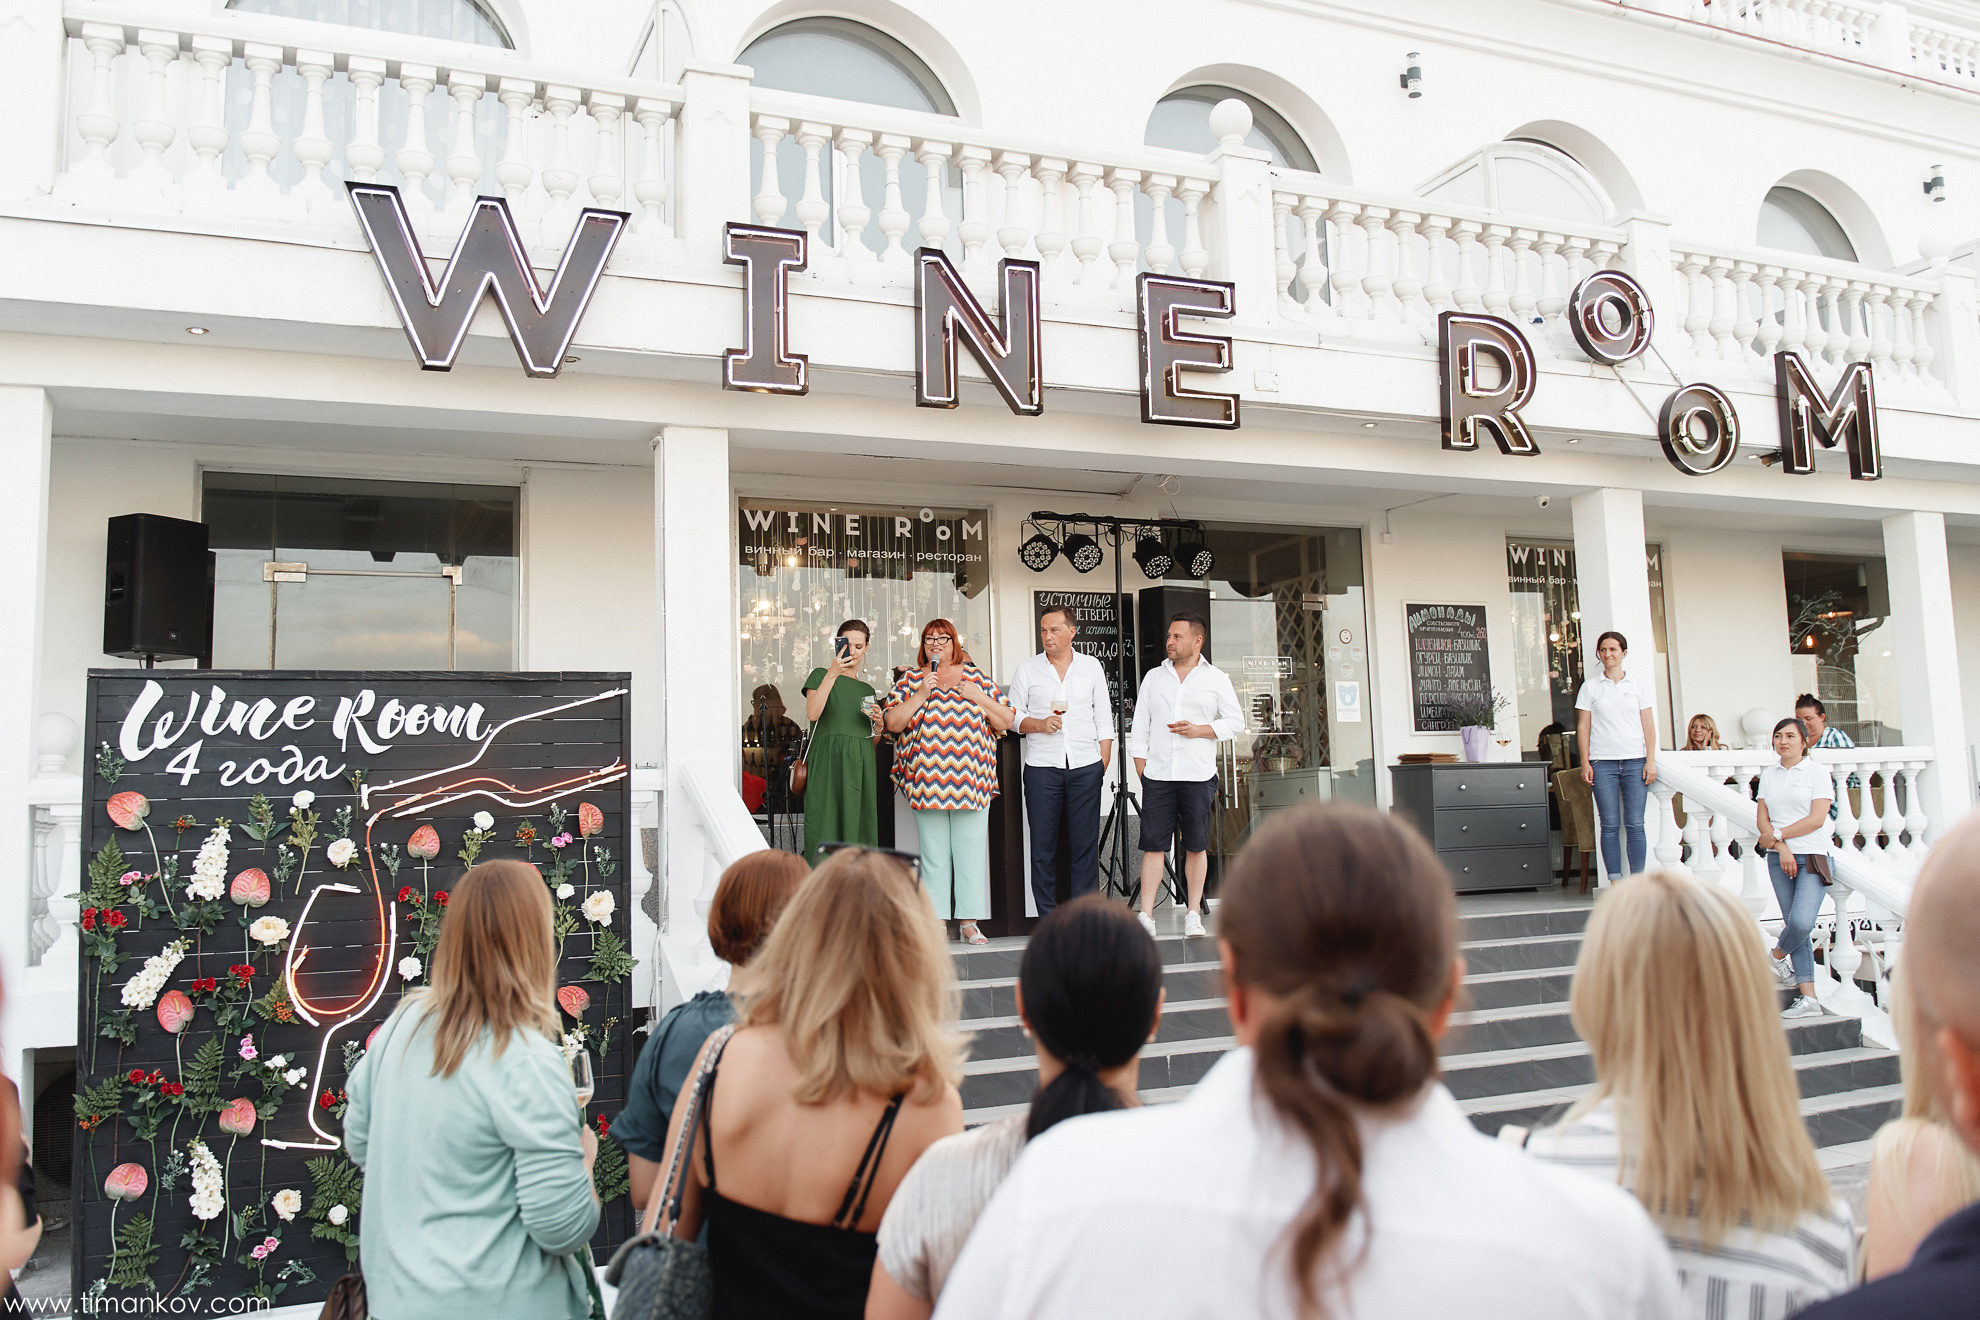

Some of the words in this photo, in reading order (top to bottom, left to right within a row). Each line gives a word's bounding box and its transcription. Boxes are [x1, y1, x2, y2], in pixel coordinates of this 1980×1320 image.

[344, 181, 1241, 430] WINE
[1438, 270, 1883, 480] ROOM
[744, 509, 860, 536] WINE
[895, 508, 982, 541] ROOM
[745, 545, 803, 556] винный
[808, 545, 835, 559] бар
[847, 551, 905, 560] магазин
[916, 552, 982, 563] ресторан
[1509, 546, 1566, 567] WIN
[1508, 575, 1545, 584] винный
[1548, 575, 1567, 585] бар
[1408, 606, 1476, 633] ЛИМОНАДЫ
[119, 680, 315, 762] Wine
[332, 689, 493, 755] Room
[165, 739, 204, 787] 4
[218, 744, 347, 787] года
